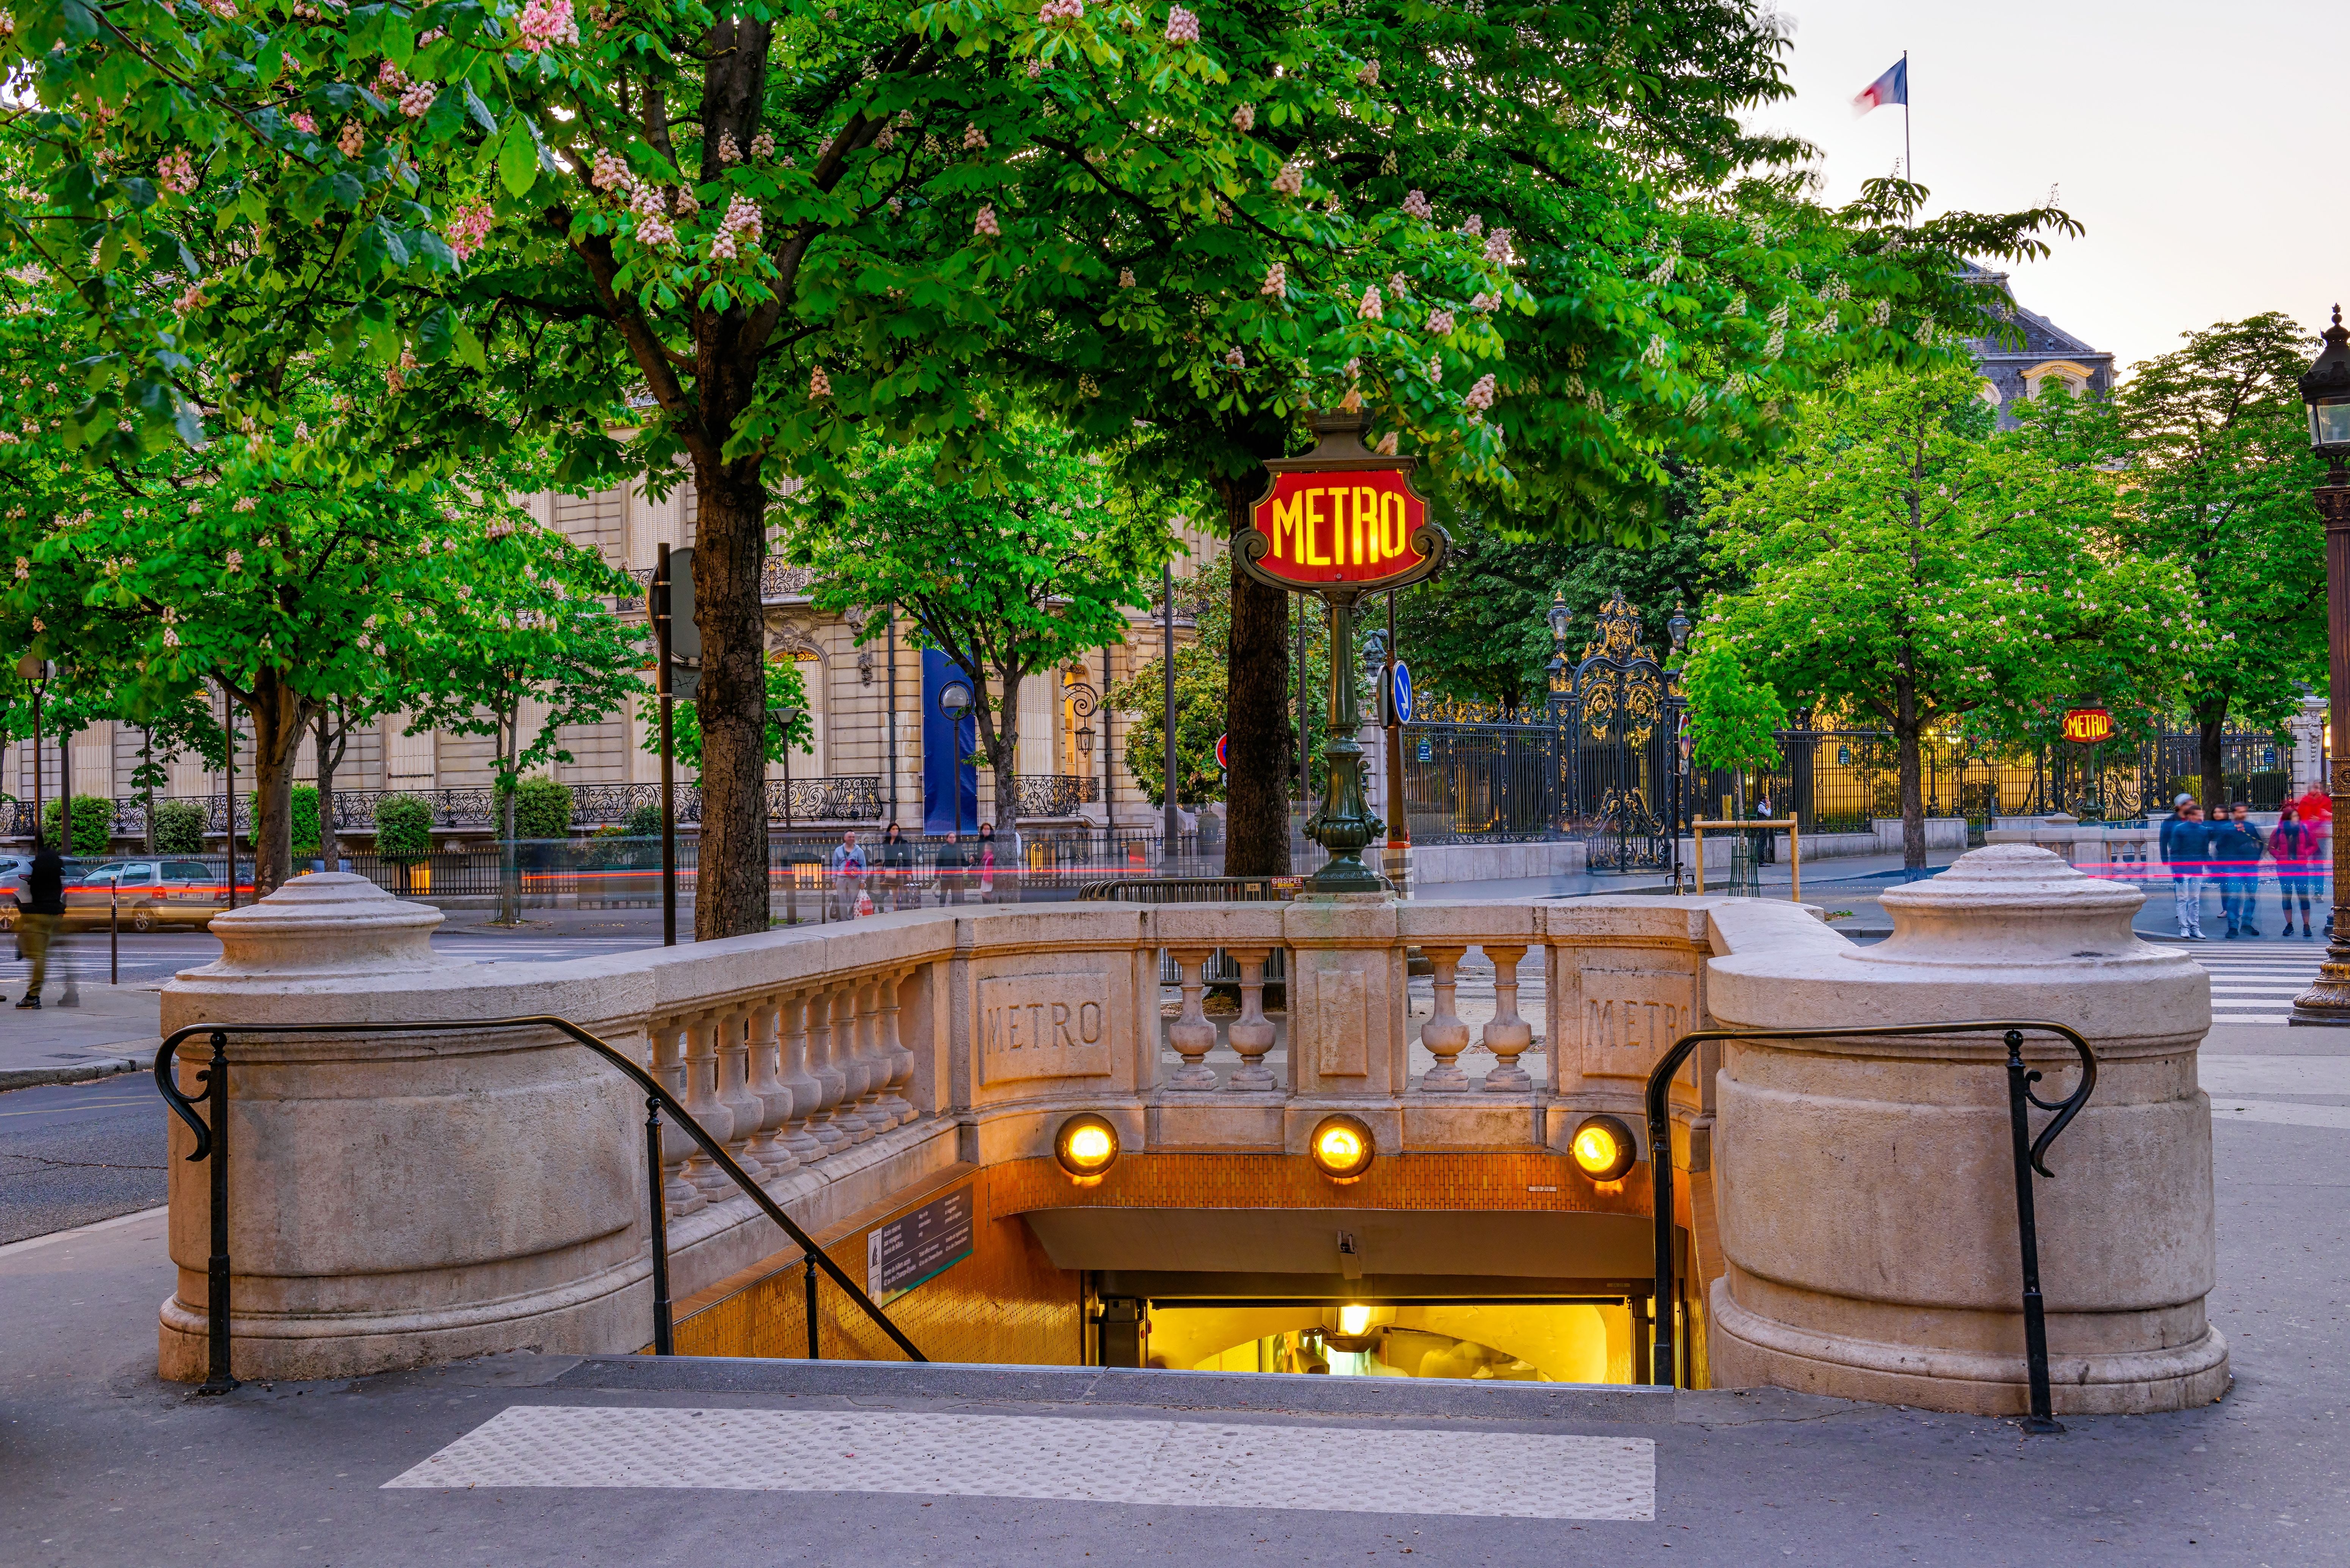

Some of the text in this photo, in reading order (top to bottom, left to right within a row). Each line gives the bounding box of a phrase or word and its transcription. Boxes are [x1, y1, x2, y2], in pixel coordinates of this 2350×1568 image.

[1272, 487, 1405, 565] METRO
[2068, 715, 2107, 737] METRO
[987, 1001, 1101, 1055] METRO
